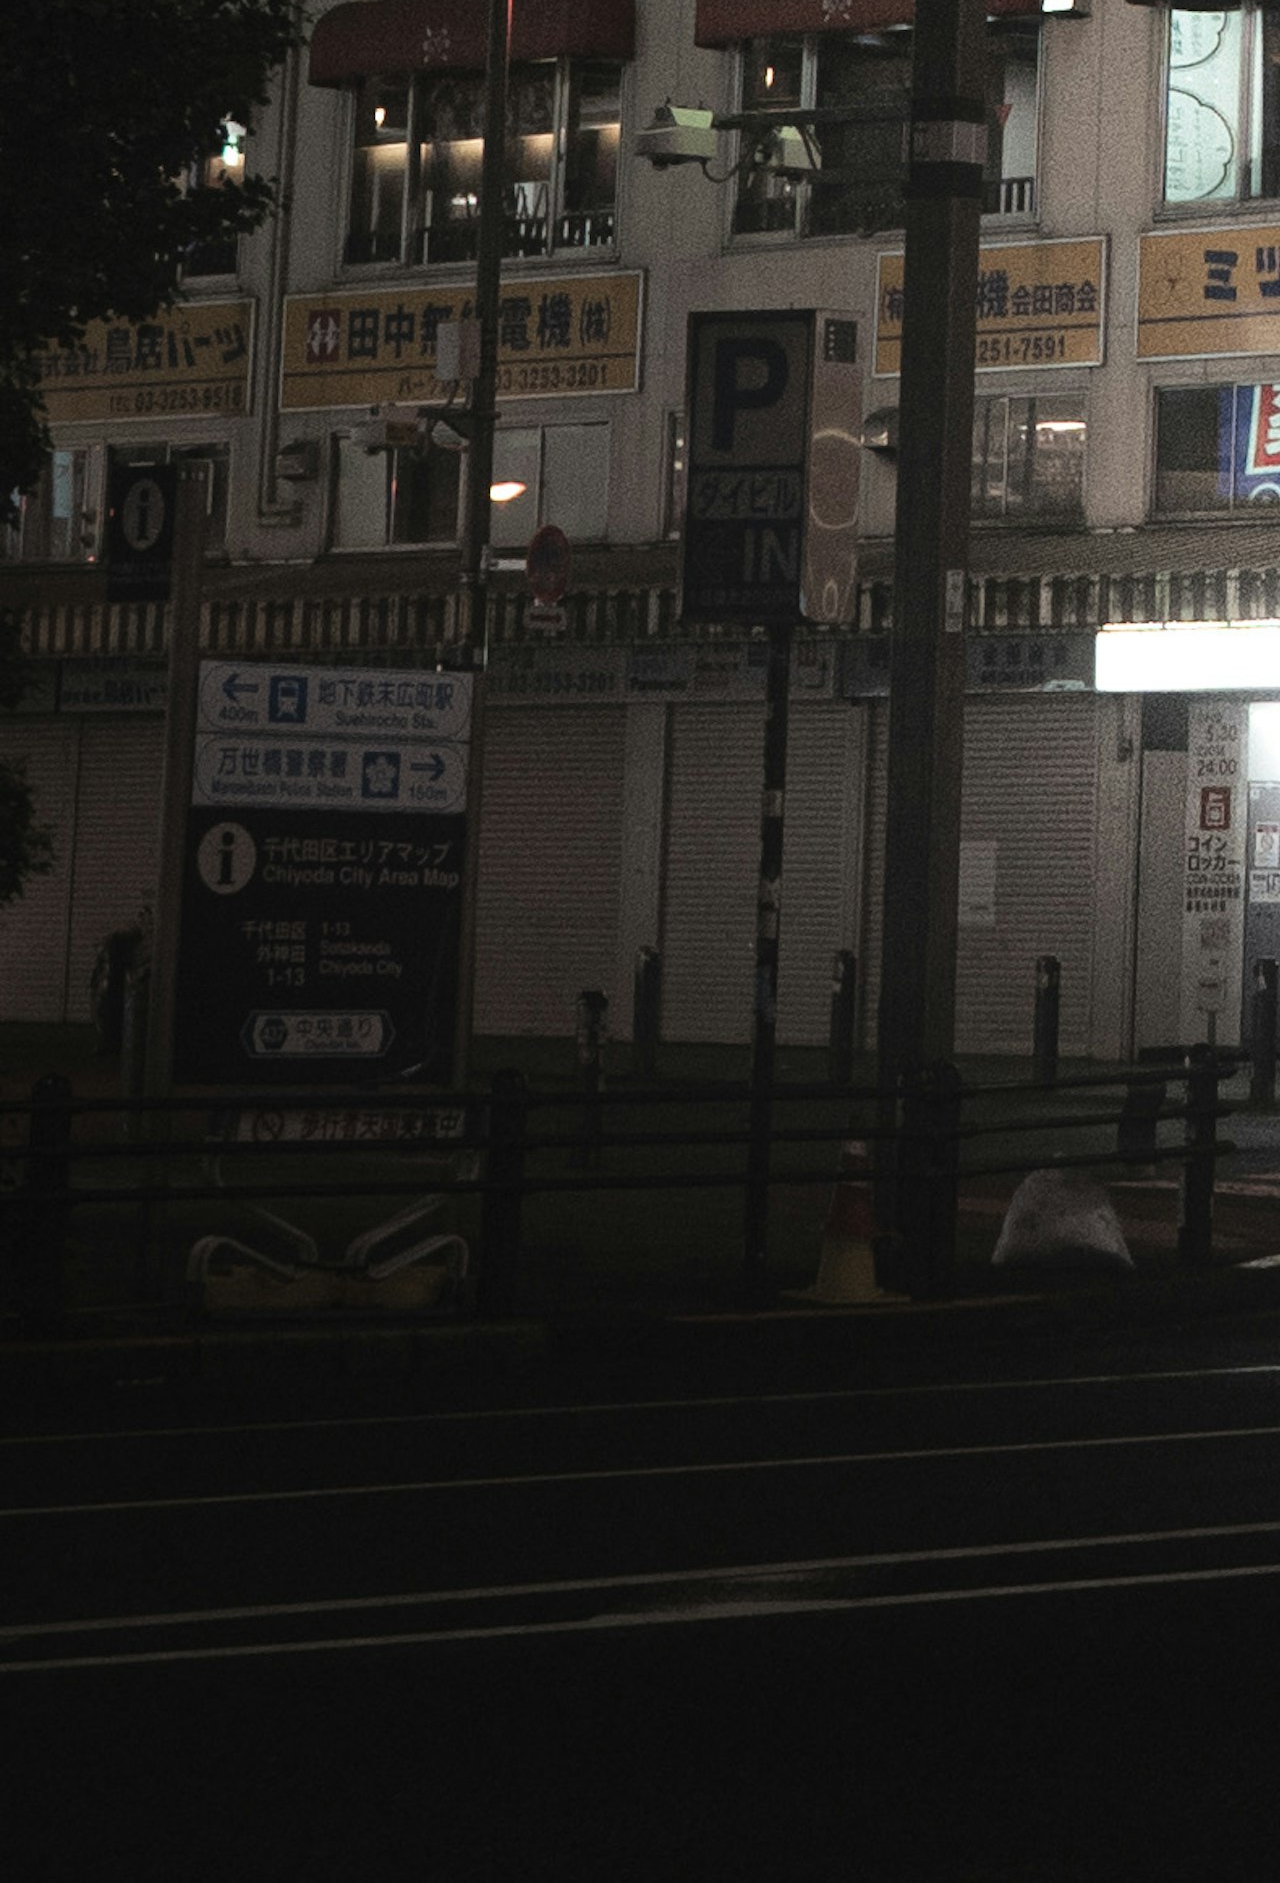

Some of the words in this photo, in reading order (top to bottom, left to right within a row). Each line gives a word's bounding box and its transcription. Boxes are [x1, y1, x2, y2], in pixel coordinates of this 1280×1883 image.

[712, 338, 789, 452] P
[742, 527, 798, 583] IN
[218, 706, 259, 725] 400m
[263, 836, 453, 866] 千代田区エリアマップ
[1188, 836, 1228, 853] コイン
[1188, 854, 1241, 872] ロッカー
[262, 865, 335, 888] Chiyoda
[339, 866, 374, 889] City
[377, 868, 419, 886] Area
[423, 868, 461, 892] Map
[242, 919, 306, 941] 千代田区
[267, 967, 306, 987] 1-13
[318, 960, 374, 979] Chiyoda
[375, 961, 404, 980] City
